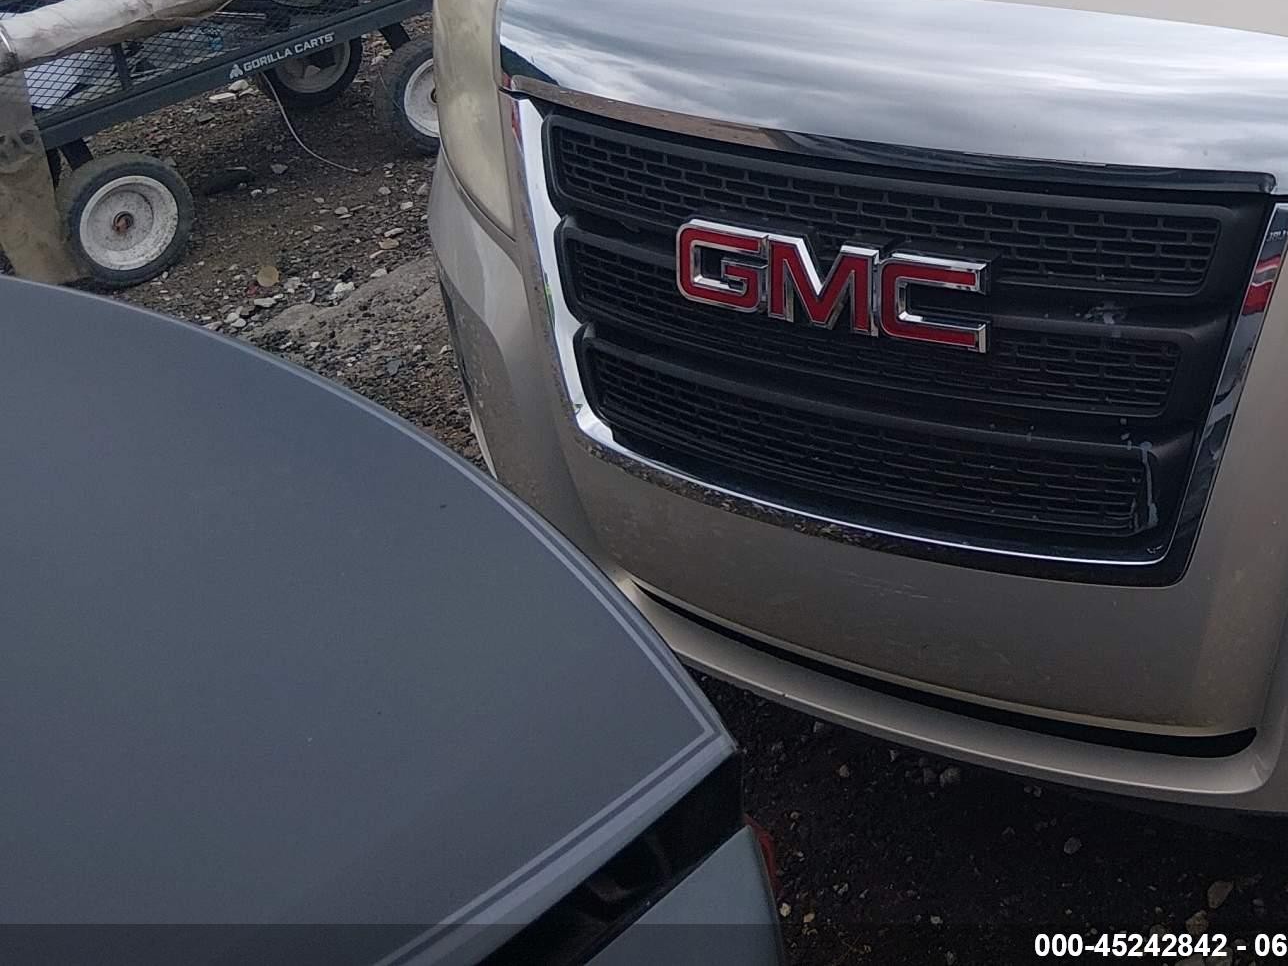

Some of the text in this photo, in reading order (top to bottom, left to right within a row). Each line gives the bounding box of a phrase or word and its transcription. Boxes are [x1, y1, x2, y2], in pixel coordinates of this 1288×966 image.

[243, 32, 336, 72] GORILLA CARTS
[675, 218, 988, 354] GMC
